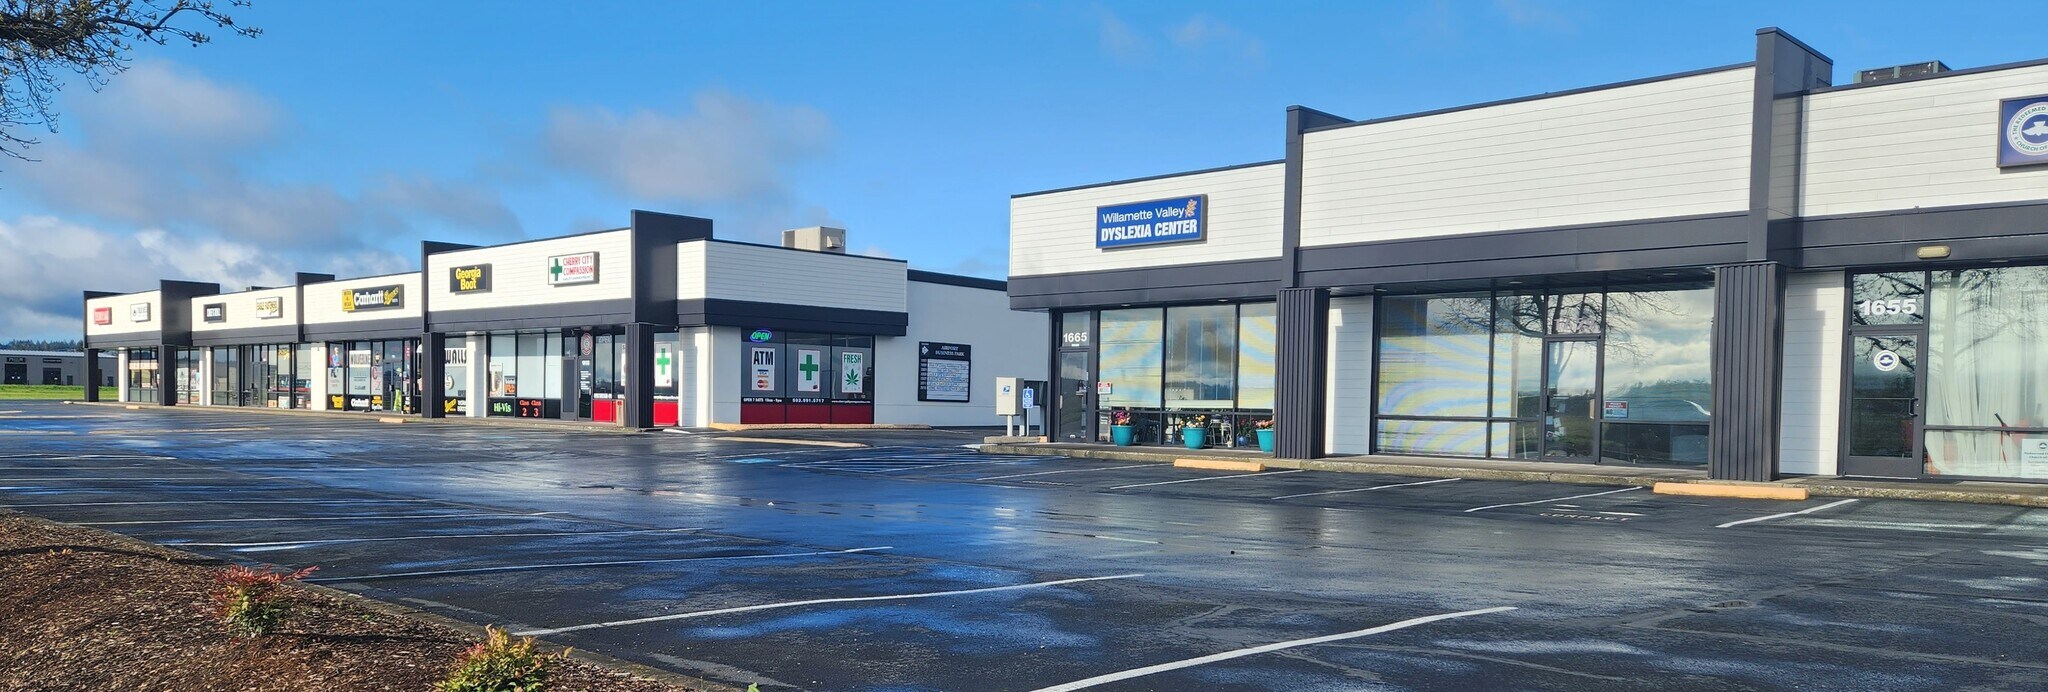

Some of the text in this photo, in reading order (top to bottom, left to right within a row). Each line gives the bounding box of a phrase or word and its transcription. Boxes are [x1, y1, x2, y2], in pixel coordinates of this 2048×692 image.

[2016, 107, 2046, 124] REDEEMED
[2016, 140, 2039, 152] CHURCH
[1102, 206, 1184, 224] Willamette Valley
[1101, 219, 1198, 242] DYSLEXIA CENTER
[563, 255, 593, 266] CHERRY CITY
[455, 266, 481, 280] Georgia
[563, 265, 593, 276] COMPASSION
[460, 278, 477, 290] Boot
[353, 290, 384, 306] Carhartt
[1859, 298, 1917, 316] 1655
[752, 331, 770, 340] OPEN
[1063, 332, 1087, 343] 1665
[753, 351, 774, 365] ATM
[843, 353, 862, 364] FRESH
[494, 402, 511, 413] Hi-Vis
[522, 407, 539, 417] 2 3
[1539, 513, 1632, 521] COMPACT
